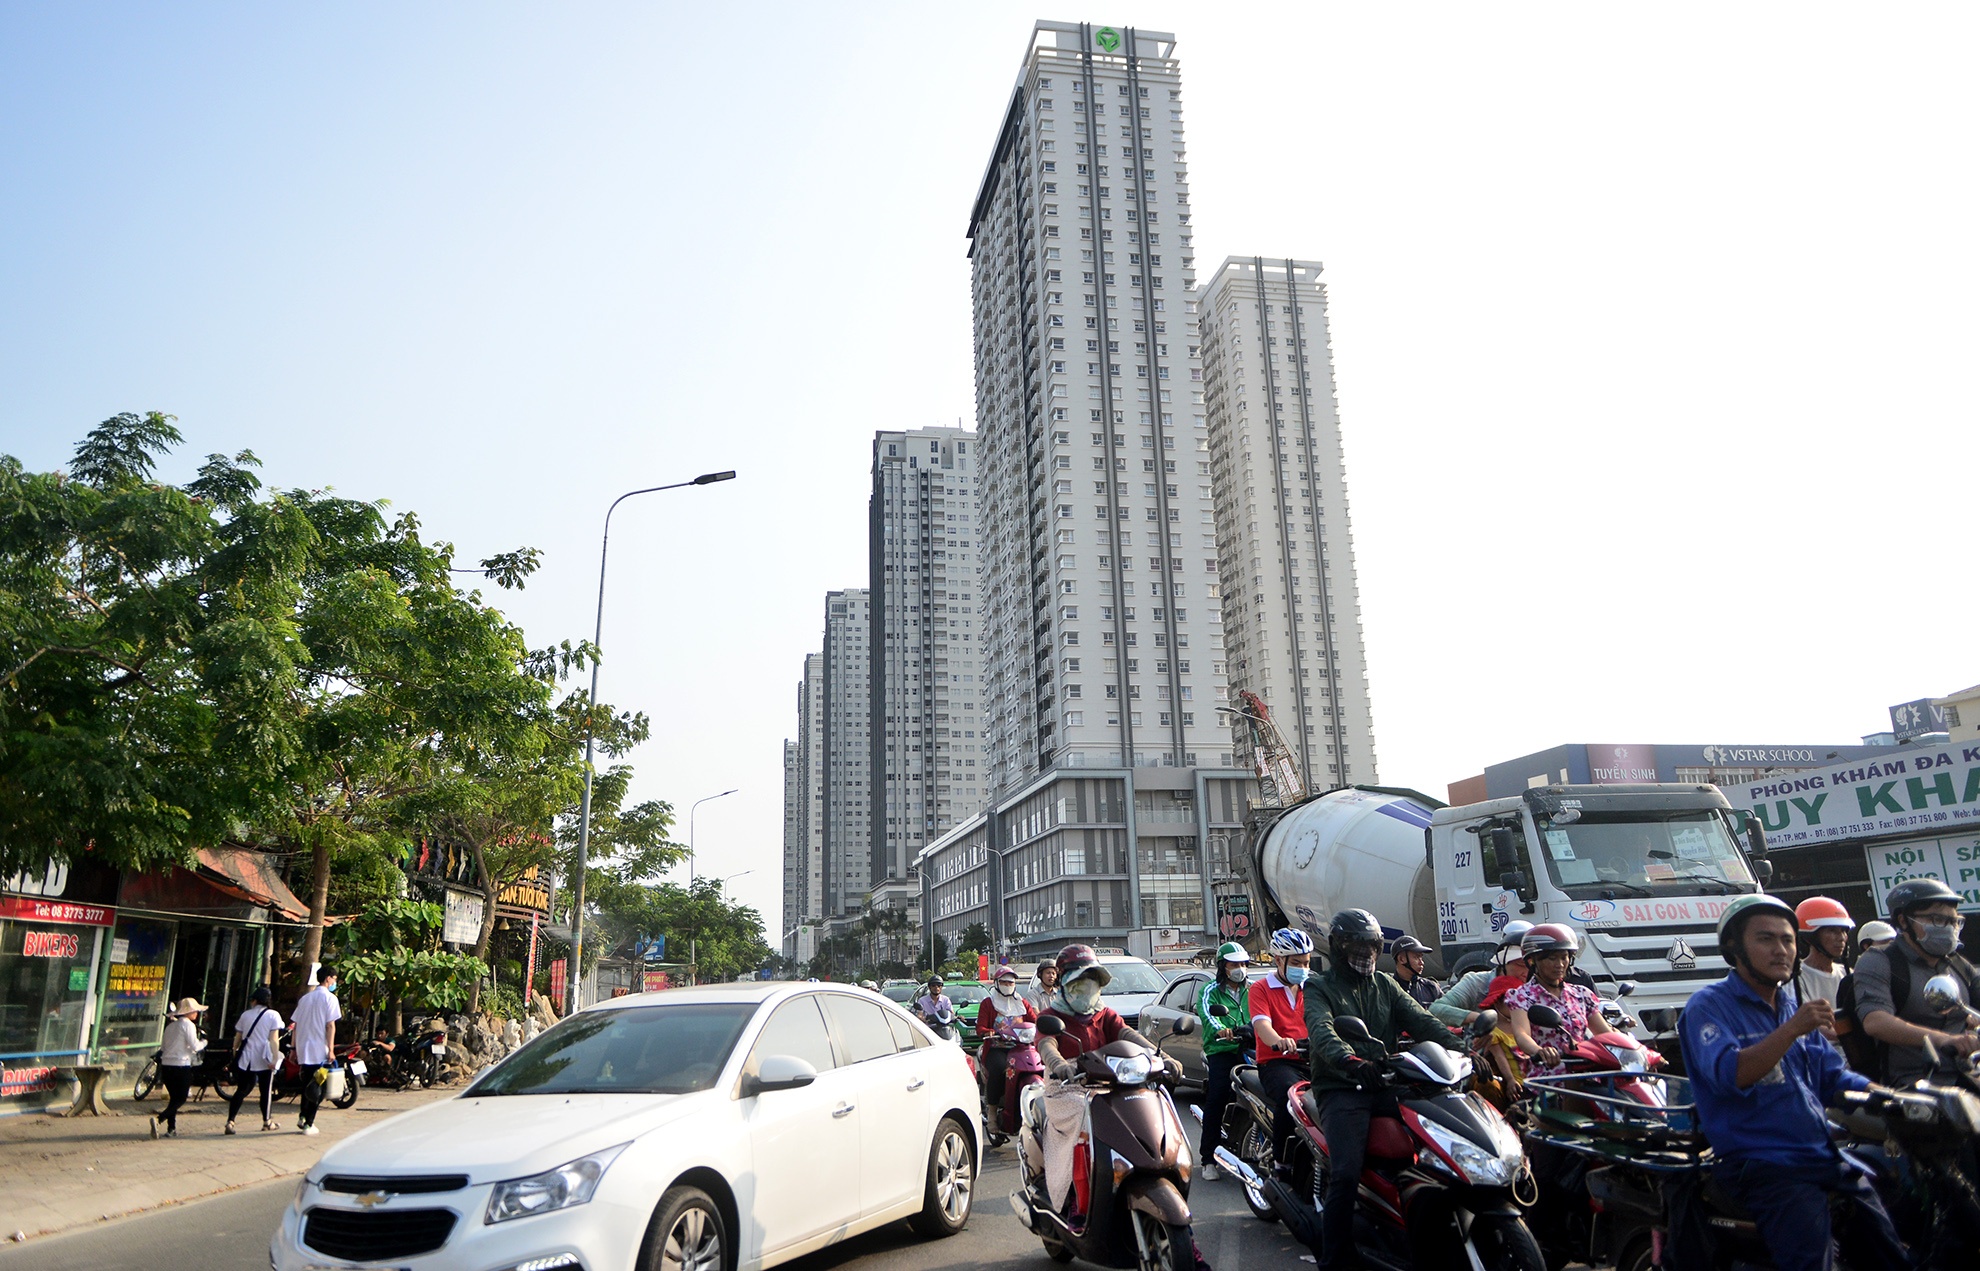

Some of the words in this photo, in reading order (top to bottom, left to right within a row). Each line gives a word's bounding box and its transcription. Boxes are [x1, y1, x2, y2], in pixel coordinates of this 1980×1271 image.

[1729, 749, 1766, 762] VSTAR
[1769, 750, 1817, 762] SCHOOL
[1593, 763, 1628, 780] TUYỂN
[1630, 768, 1656, 780] SINH
[1750, 775, 1825, 800] PHÒNG
[1832, 761, 1906, 786] KHÁM
[1914, 752, 1953, 771] ĐA
[1766, 836, 1777, 847] uận
[1784, 833, 1794, 842] TP.
[1795, 831, 1808, 841] HCM
[1827, 826, 1839, 837] (08)
[1840, 826, 1848, 835] 37
[1849, 822, 1861, 834] 751
[1862, 822, 1875, 831] 333
[1879, 820, 1893, 829] Fax:
[1894, 817, 1908, 828] (08)
[1909, 815, 1918, 825] 37
[1919, 814, 1932, 824] 751
[1934, 812, 1948, 822] 800
[1952, 809, 1971, 820] Web:
[1455, 851, 1471, 868] 227
[1885, 847, 1925, 866] NỘI
[35, 903, 50, 917] Tel:
[51, 904, 63, 917] 08
[63, 906, 84, 920] 3775
[85, 909, 105, 921] 3777
[1440, 902, 1456, 917] 51E
[23, 931, 79, 958] BIKERS
[0, 1066, 58, 1096] BIKERS
